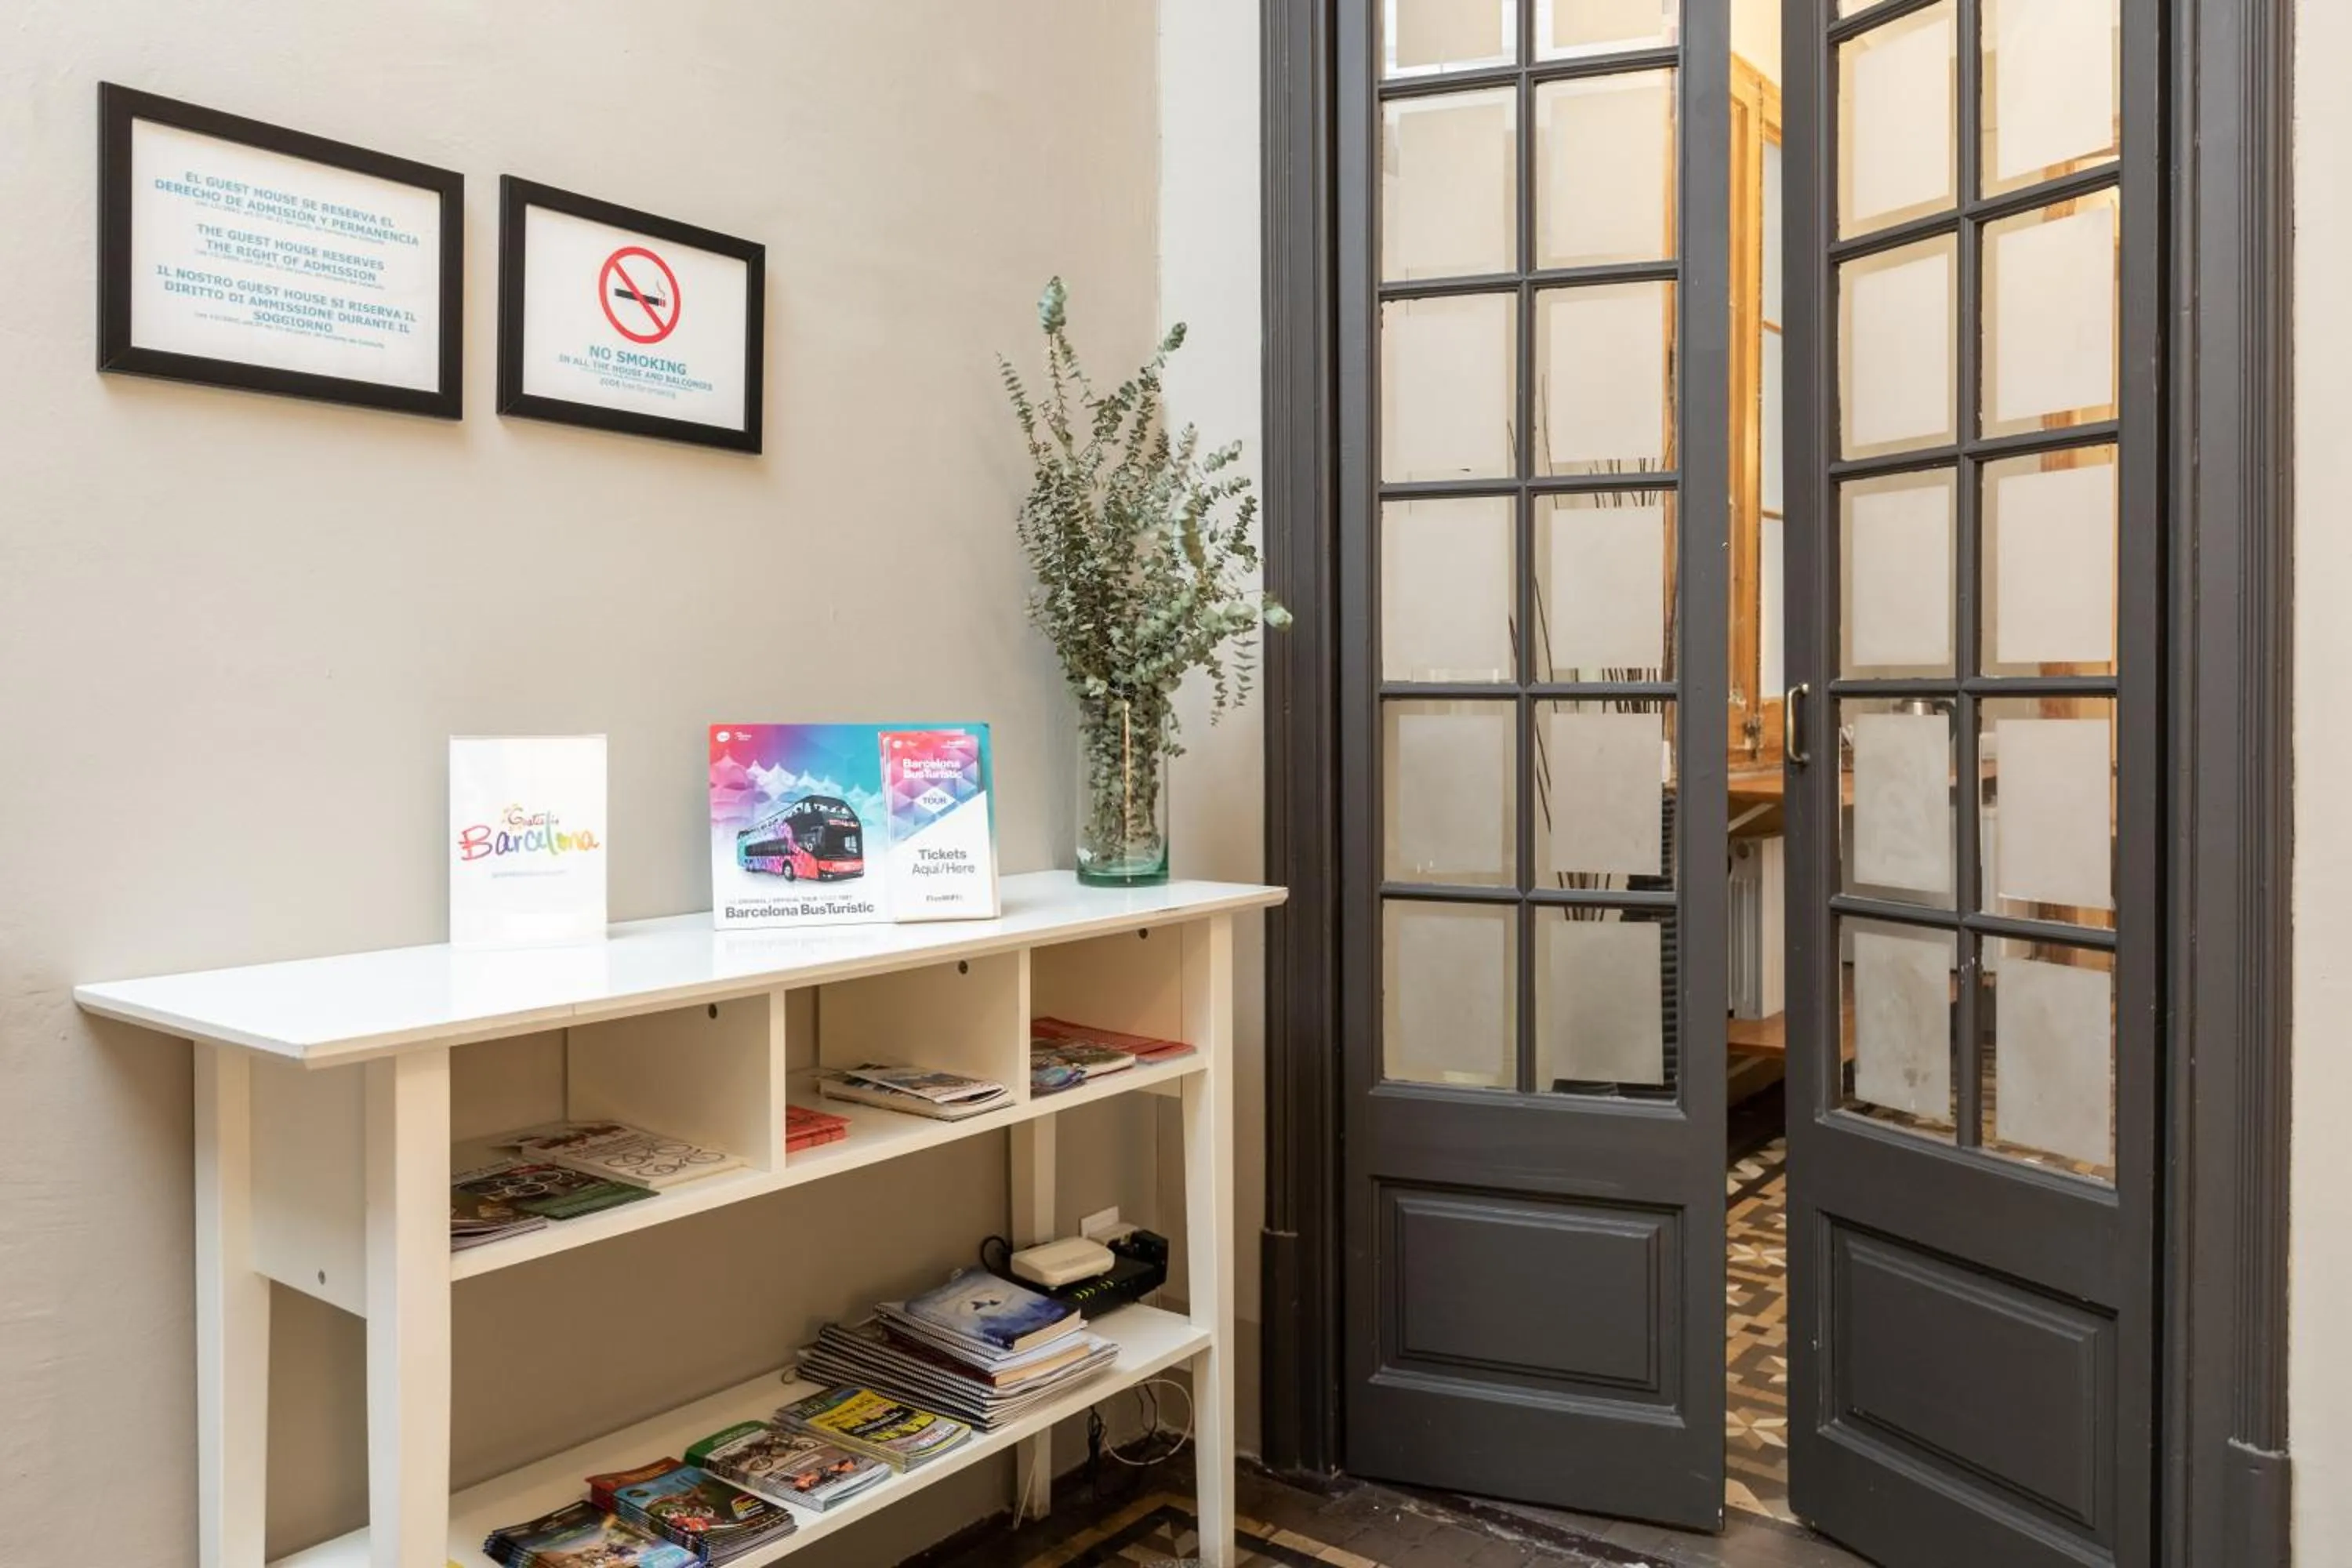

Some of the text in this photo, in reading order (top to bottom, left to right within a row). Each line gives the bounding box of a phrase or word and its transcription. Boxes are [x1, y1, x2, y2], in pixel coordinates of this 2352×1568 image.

[154, 179, 222, 201] DERECHO
[226, 194, 243, 206] DE
[247, 199, 316, 223] ADMISIÓN
[320, 216, 329, 226] Y
[332, 218, 419, 246] PERMANENCIA
[186, 171, 394, 228] EL GUEST HOUSE SE RESERVA EL
[197, 223, 223, 238] THE
[227, 230, 270, 247] GUEST
[274, 240, 318, 256] HOUSE
[322, 249, 385, 270] RESERVES
[206, 239, 376, 281] THE RIGHT OF ADMISSION
[156, 265, 416, 322] IL NOSTRO GUEST HOUSE SI RISERVA IL
[164, 281, 224, 299] DIRITTO
[228, 292, 245, 304] DI
[249, 296, 336, 320] AMMISSIONE
[338, 312, 396, 331] DURANTE
[398, 323, 410, 333] IL
[252, 310, 333, 333] SOGGIORNO
[573, 358, 589, 366] ALL
[593, 361, 609, 370] THE
[612, 365, 642, 377] HOUSE
[645, 370, 664, 381] AND
[588, 345, 688, 376] NO SMOKING
[903, 758, 960, 769] Barcelona
[903, 769, 964, 779] BusTuristic
[459, 811, 601, 861] Barcelona
[917, 846, 967, 860] Tickets
[725, 905, 798, 919] Barcelona
[800, 901, 875, 916] BusTuristic
